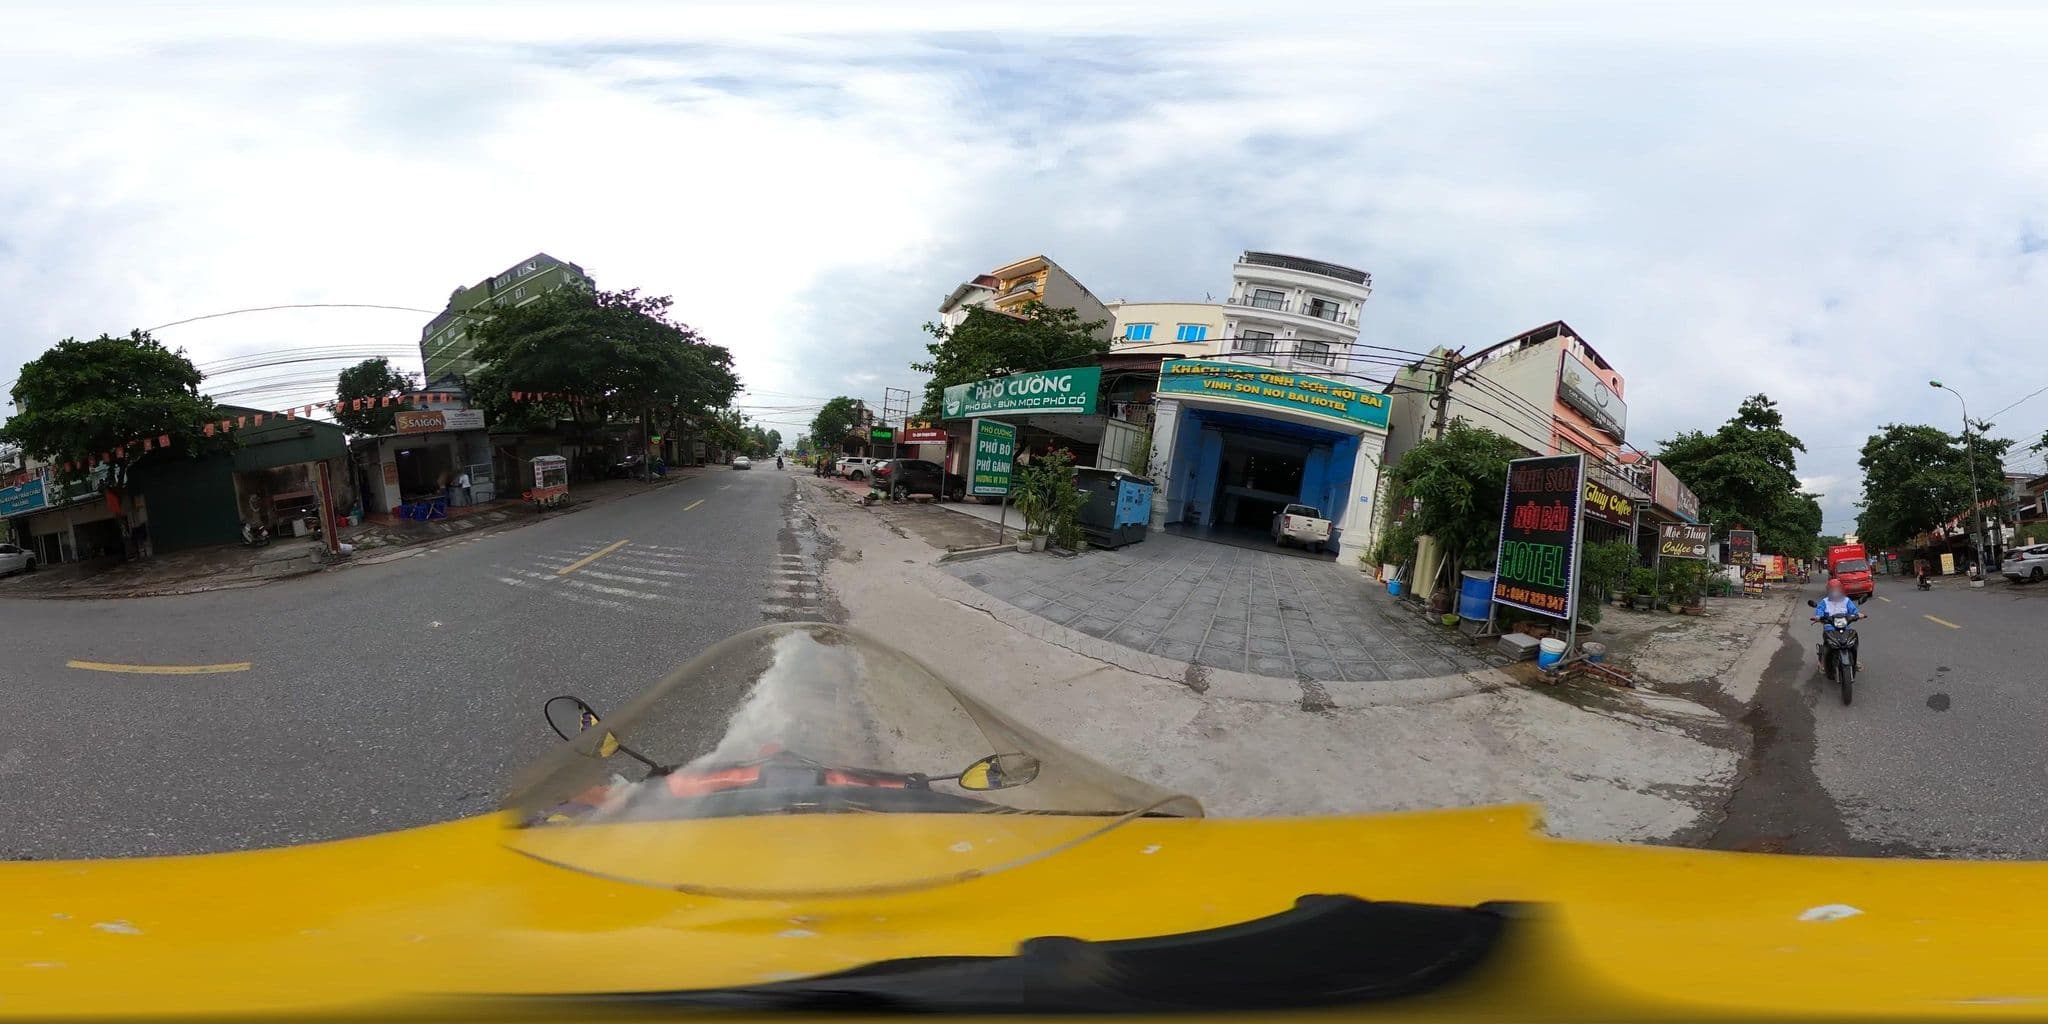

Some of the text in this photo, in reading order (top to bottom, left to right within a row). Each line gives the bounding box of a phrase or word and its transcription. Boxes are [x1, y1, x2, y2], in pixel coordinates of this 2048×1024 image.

[1008, 375, 1073, 395] CƯỜNG
[1203, 380, 1232, 390] VINH
[1235, 384, 1260, 394] SON
[1264, 389, 1284, 398] NOI
[1288, 392, 1309, 403] BAI
[1311, 396, 1347, 411] HOTEL
[1332, 387, 1357, 401] NỘI
[1360, 393, 1383, 408] BÀI
[409, 419, 442, 428] SAIGON
[1662, 541, 1692, 555] Coffee
[1499, 540, 1566, 588] HOTEL
